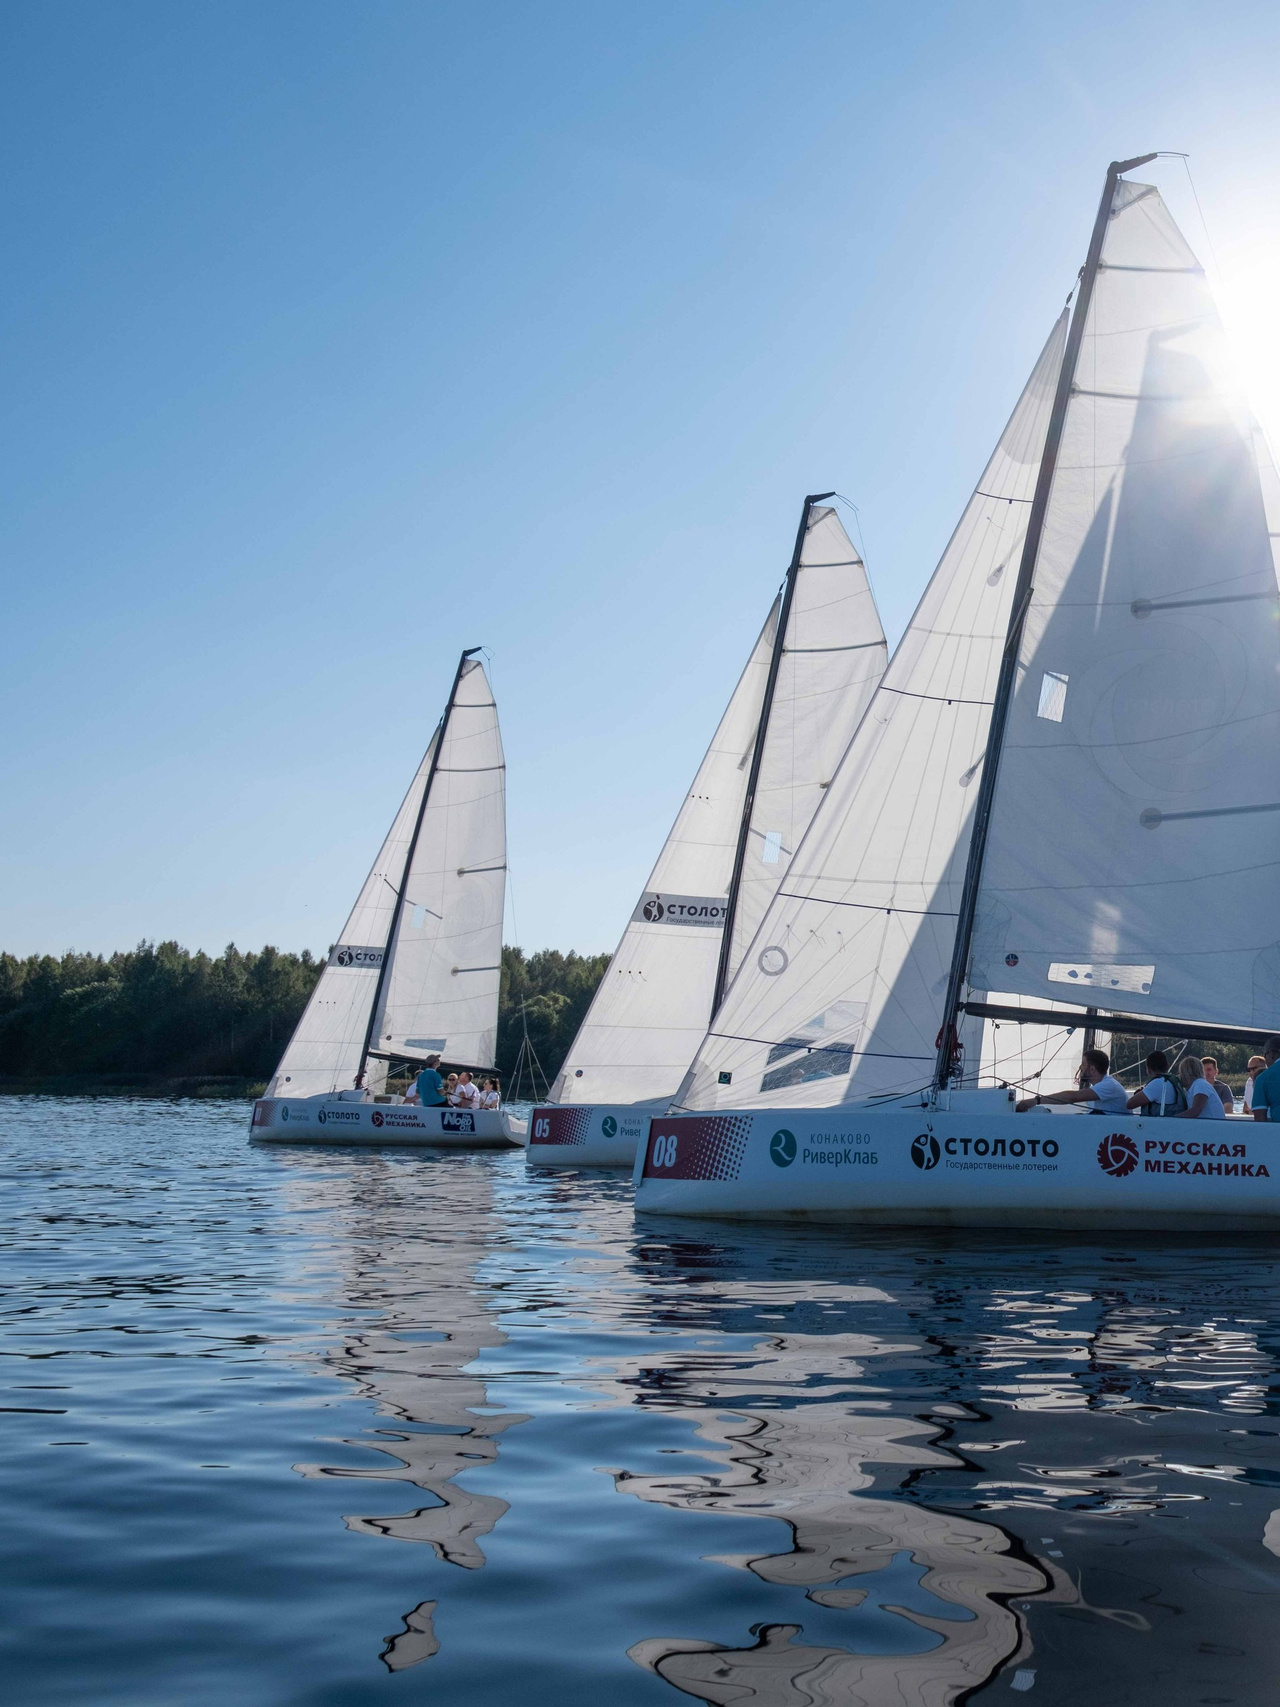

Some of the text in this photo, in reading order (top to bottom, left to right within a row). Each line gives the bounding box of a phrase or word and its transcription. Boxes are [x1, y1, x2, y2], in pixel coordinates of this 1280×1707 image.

[667, 904, 728, 918] СТОЛОТ
[356, 953, 382, 962] СТОЛ
[327, 1111, 360, 1120] СТОЛОТО
[444, 1112, 472, 1126] NORD
[535, 1118, 550, 1138] 05
[810, 1134, 871, 1144] КОНАКОВО
[653, 1135, 678, 1167] 08
[944, 1137, 1059, 1158] СТОЛОТО
[1145, 1140, 1246, 1157] РУССКАЯ
[803, 1148, 878, 1167] РиверКлаб
[946, 1160, 1058, 1172] Государственные лотереи
[1144, 1160, 1270, 1177] МЕХАНИКА
